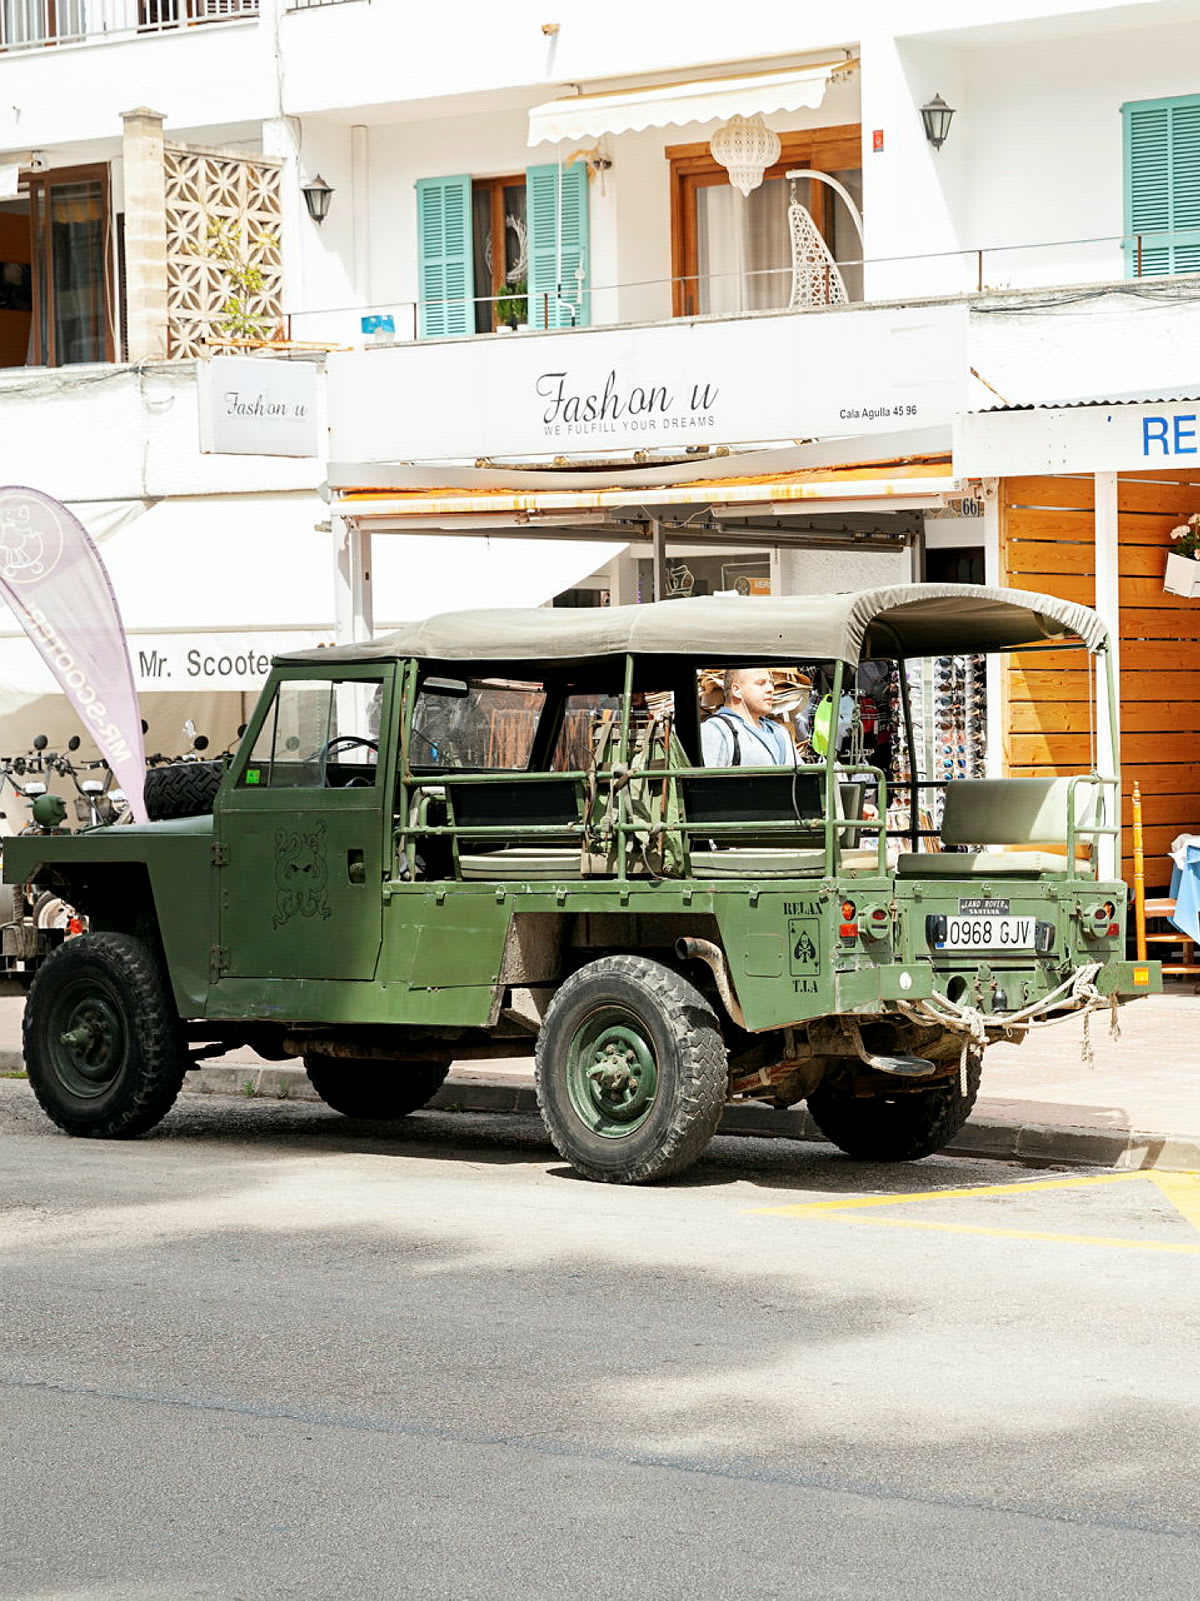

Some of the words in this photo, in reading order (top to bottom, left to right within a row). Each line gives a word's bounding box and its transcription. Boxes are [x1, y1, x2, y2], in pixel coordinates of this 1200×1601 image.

[691, 384, 718, 410] u
[295, 404, 307, 416] u
[840, 409, 859, 419] Cala
[893, 406, 903, 416] 45
[906, 405, 917, 415] 96
[544, 426, 560, 436] WE
[568, 423, 616, 435] FULFILL
[623, 420, 656, 431] YOUR
[664, 416, 715, 428] DREAMS
[962, 498, 977, 515] 66
[139, 650, 171, 678] Mr.
[187, 650, 277, 677] Scoote
[783, 902, 823, 915] RELAX
[950, 921, 992, 944] 0968
[1000, 921, 1030, 944] GJV
